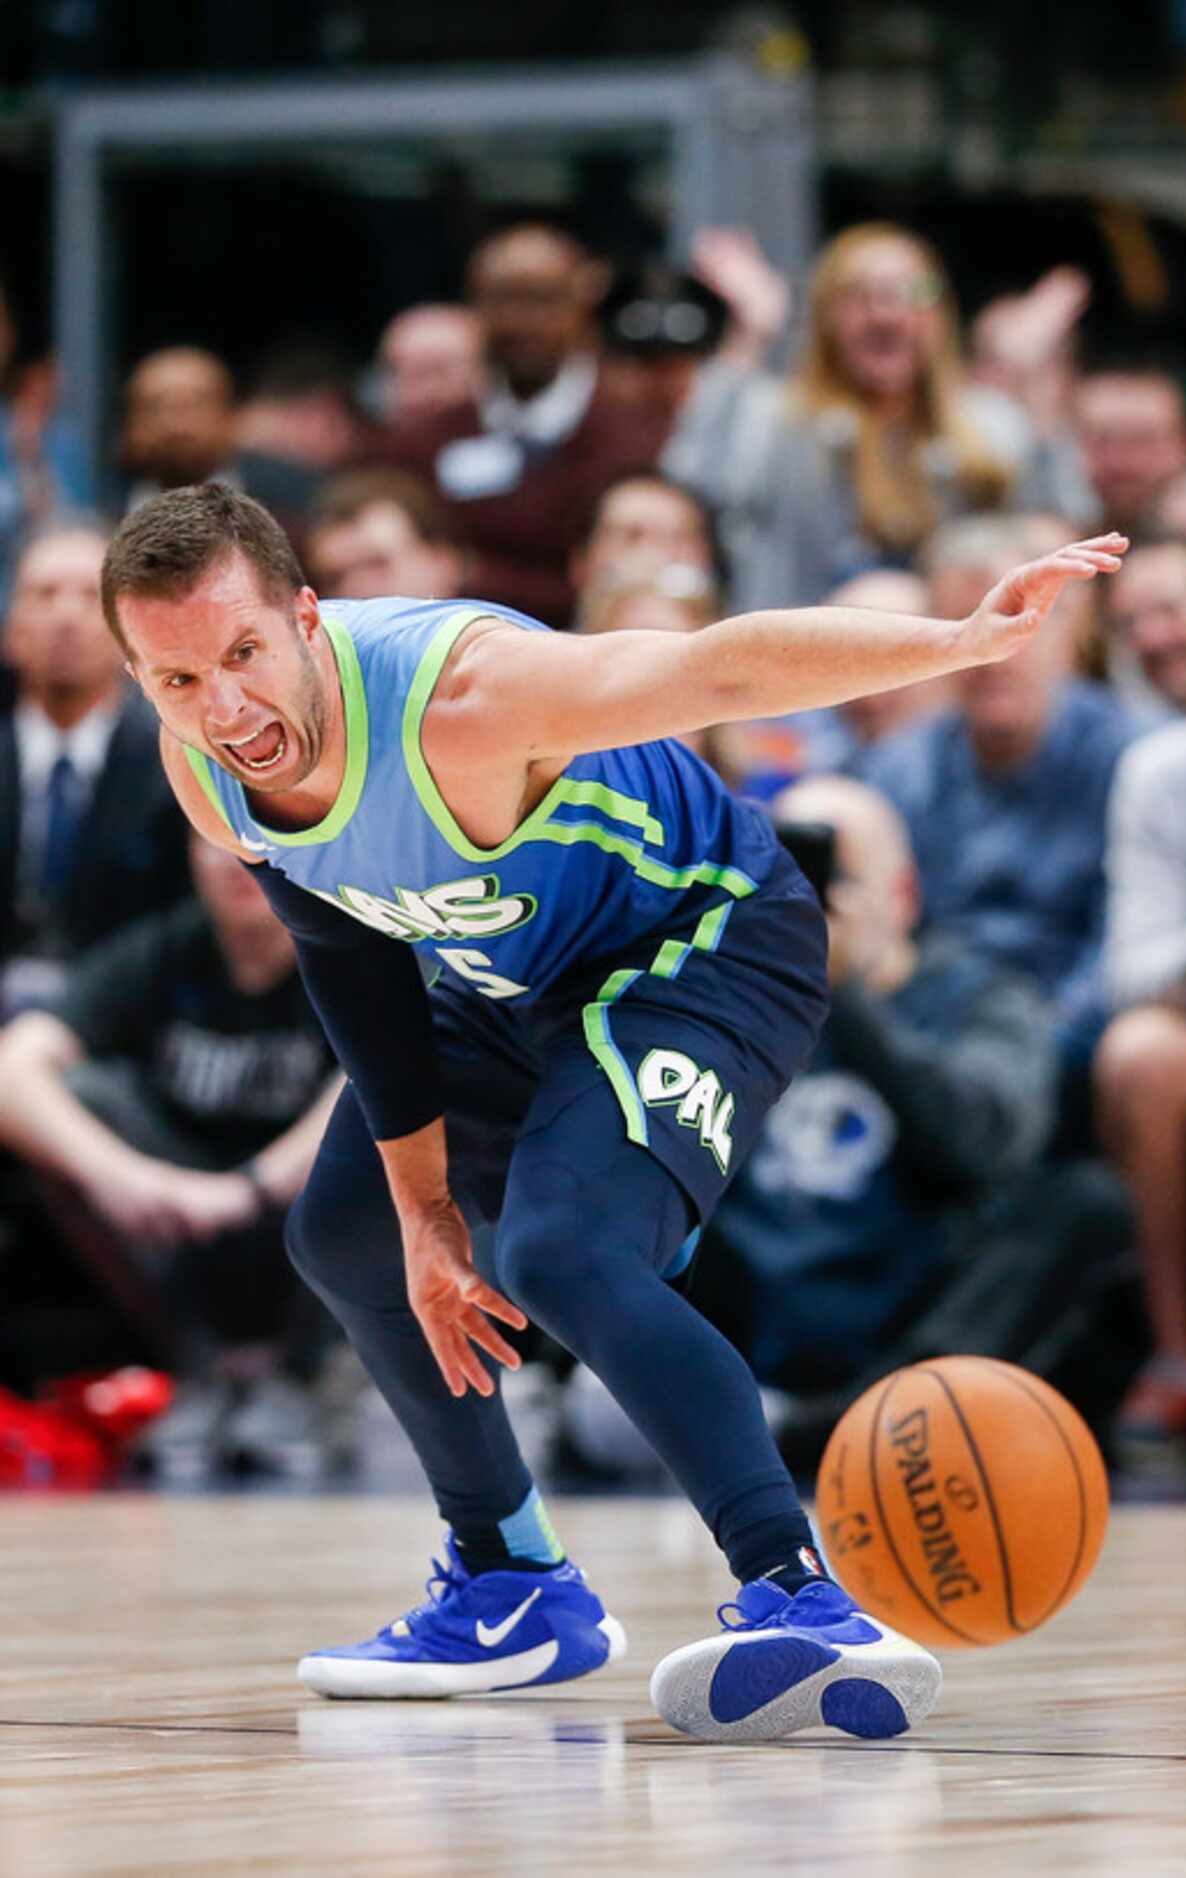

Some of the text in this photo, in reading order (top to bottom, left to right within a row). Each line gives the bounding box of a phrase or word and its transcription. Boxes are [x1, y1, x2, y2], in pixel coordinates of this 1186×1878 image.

[303, 873, 538, 943] AVS
[434, 947, 531, 999] 5
[637, 1048, 735, 1176] DAL
[889, 1408, 981, 1604] SPALDING
